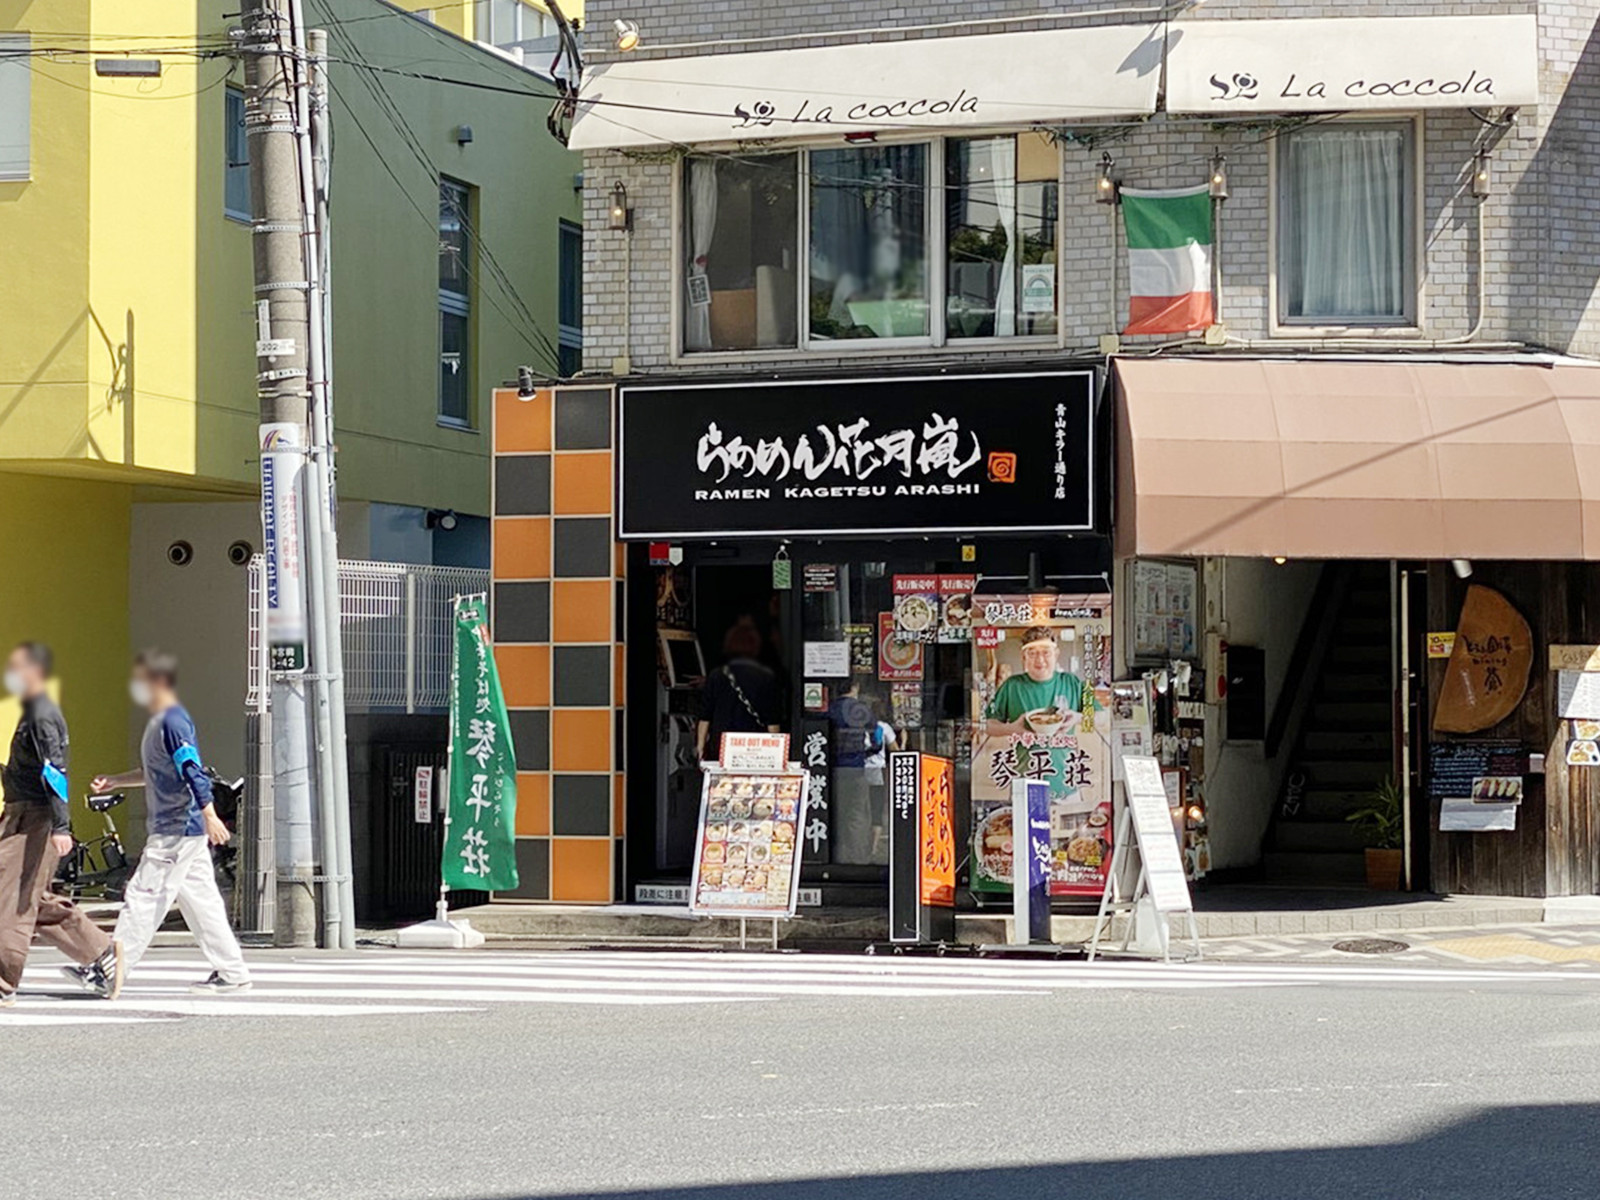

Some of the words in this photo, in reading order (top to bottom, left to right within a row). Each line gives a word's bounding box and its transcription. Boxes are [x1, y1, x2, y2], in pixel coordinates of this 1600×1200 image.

[1279, 73, 1326, 98] La
[1344, 69, 1494, 96] coccola
[791, 99, 832, 124] La
[847, 89, 980, 121] coccola
[1053, 403, 1067, 500] 青山キラー通り店
[694, 487, 771, 500] RAMEN
[784, 485, 888, 499] KAGETSU
[894, 482, 981, 496] ARASHI
[990, 749, 1093, 789] 琴平荘
[461, 718, 496, 877] 琴平荘
[803, 731, 828, 854] 営業中
